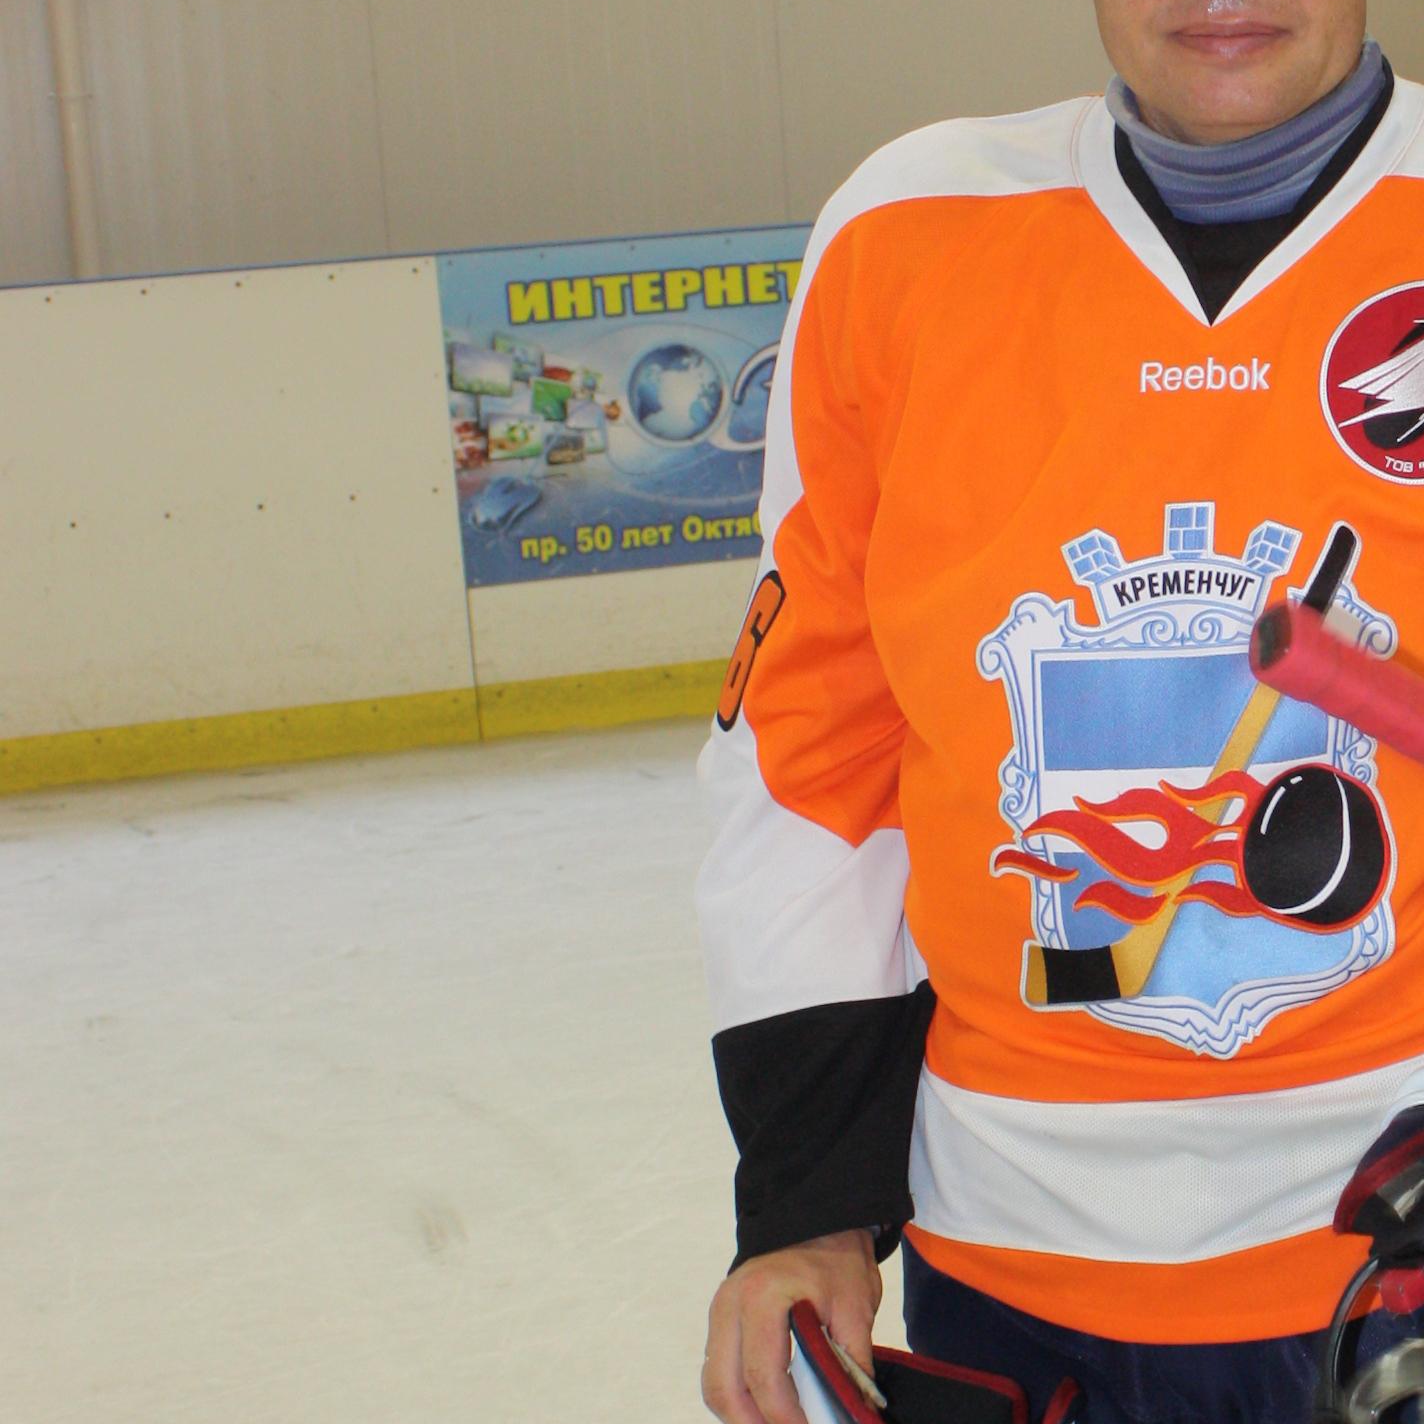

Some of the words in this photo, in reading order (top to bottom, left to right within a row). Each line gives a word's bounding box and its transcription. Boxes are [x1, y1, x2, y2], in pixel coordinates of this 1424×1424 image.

[1139, 357, 1271, 393] Reebok
[520, 535, 567, 563] пр.
[575, 525, 613, 552] 50
[621, 520, 674, 550] лет
[1112, 568, 1257, 608] КРЕМЕНЧУГ
